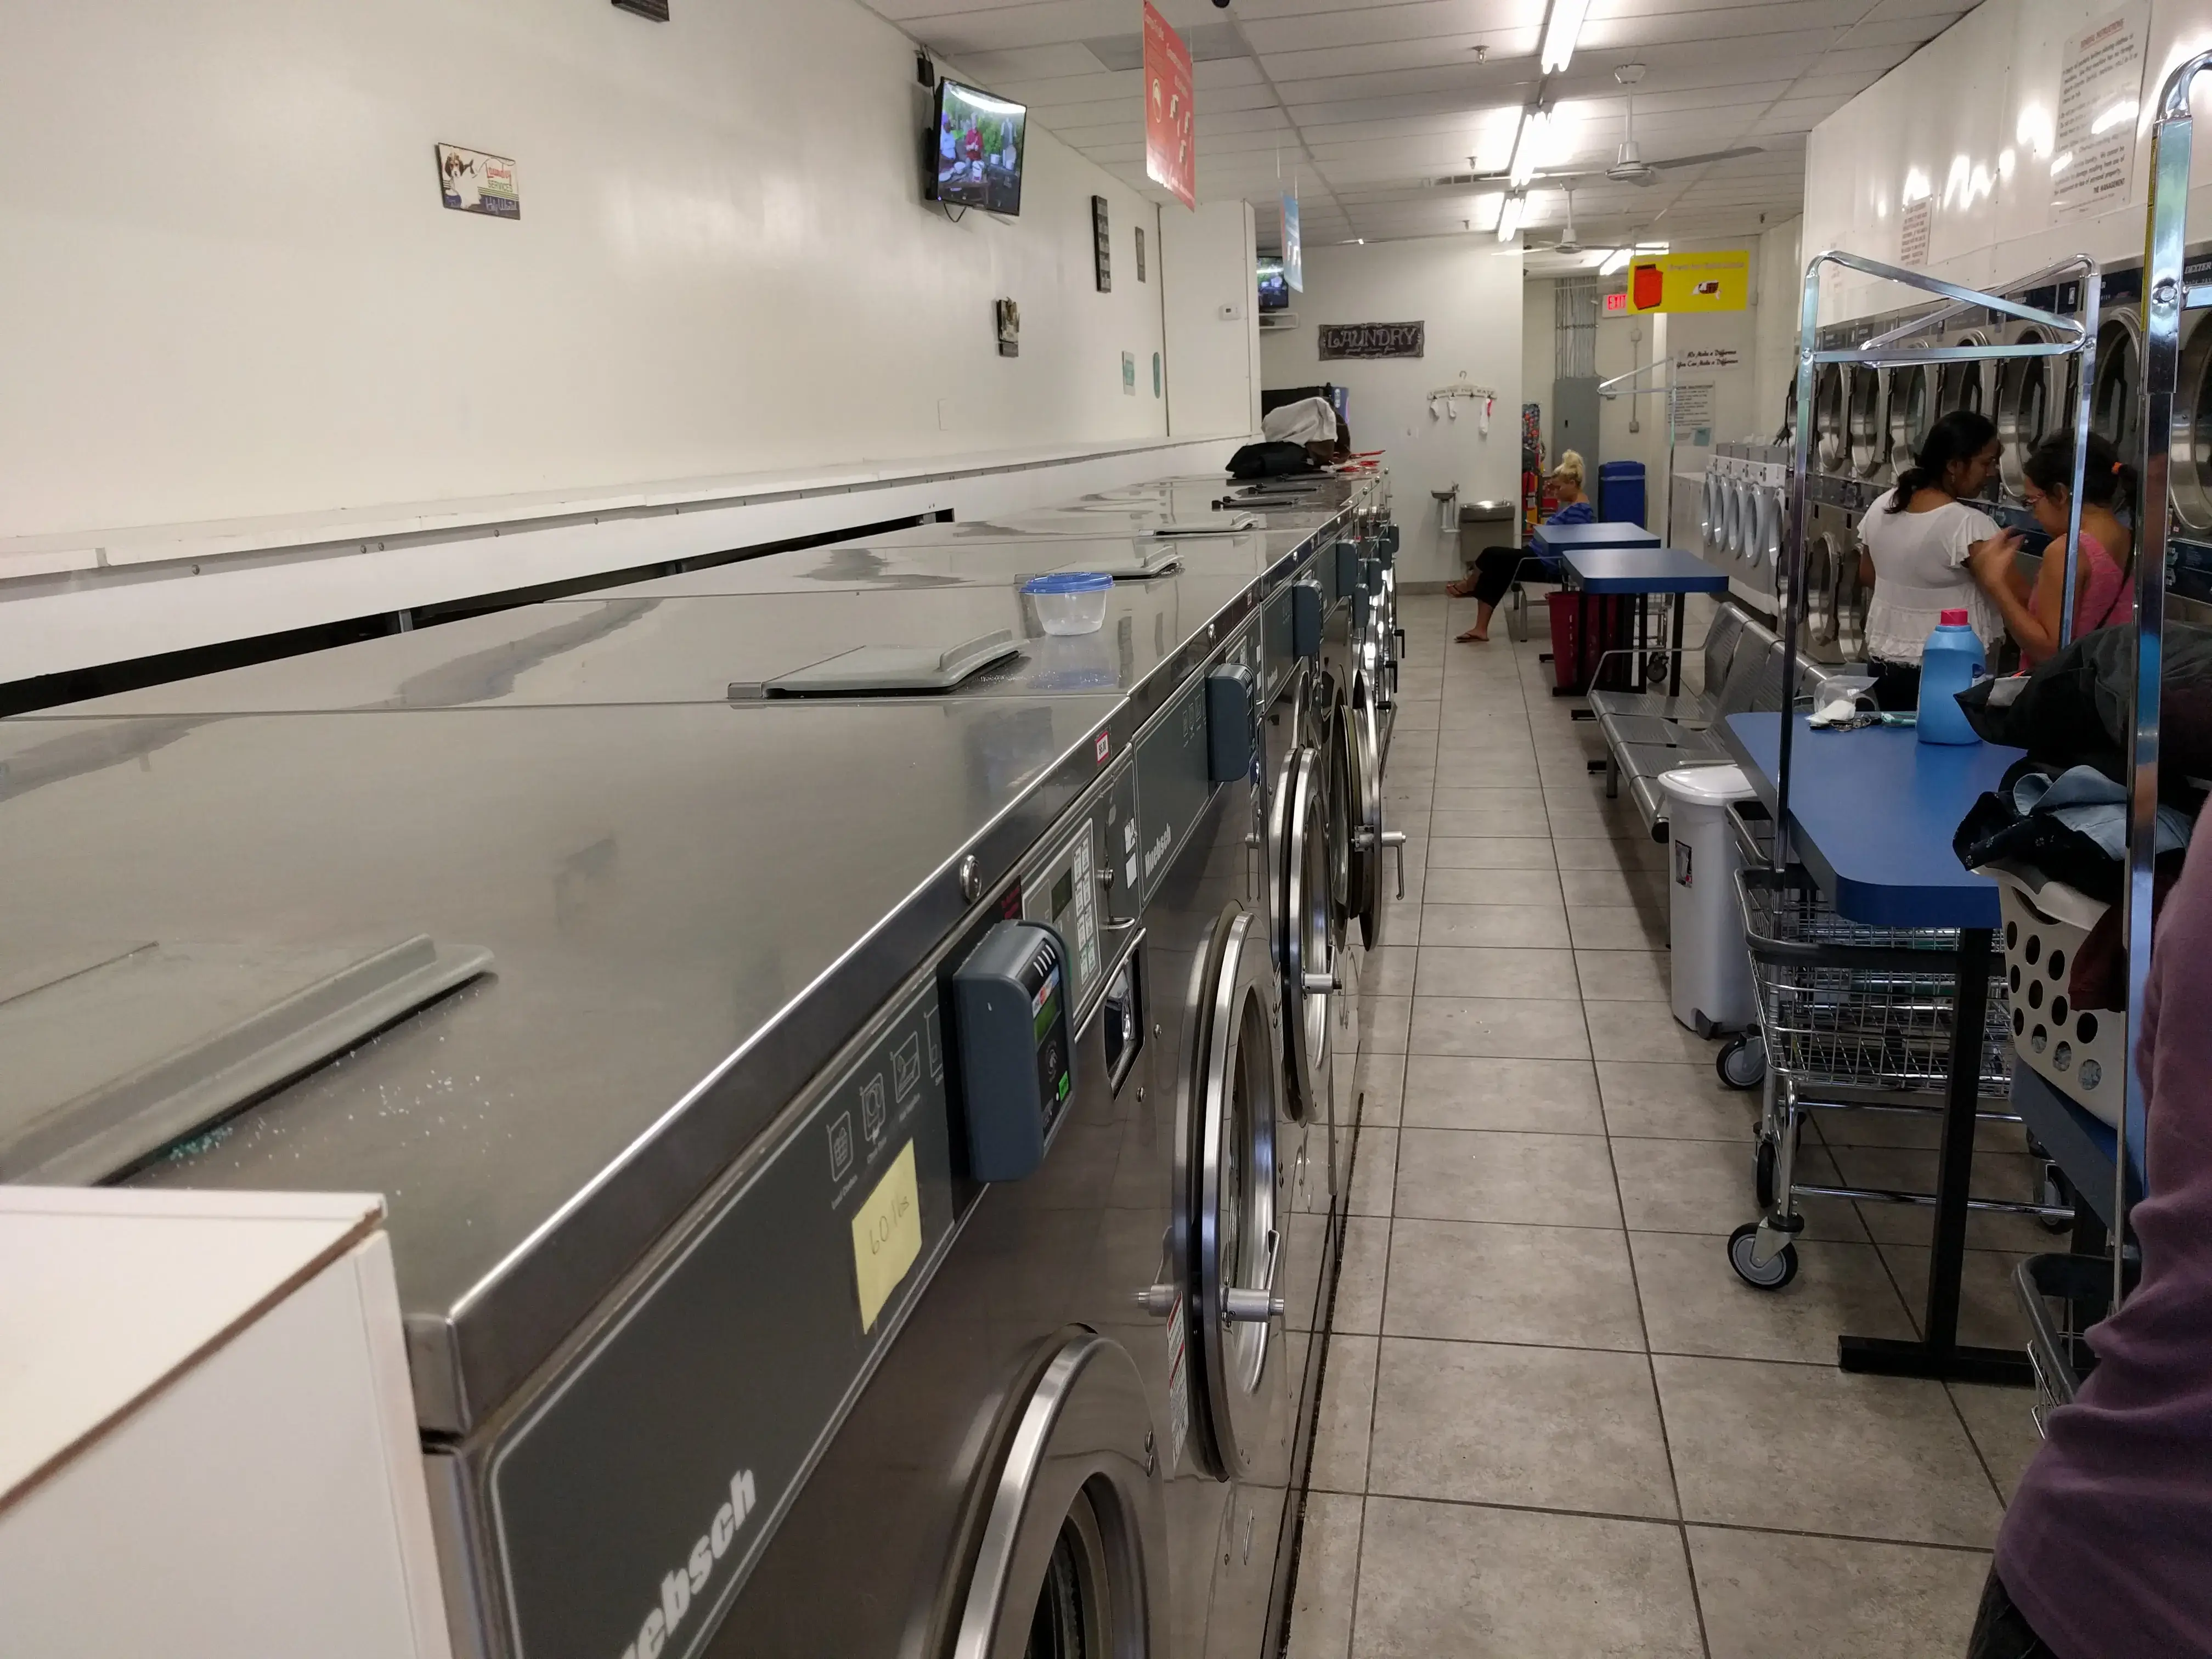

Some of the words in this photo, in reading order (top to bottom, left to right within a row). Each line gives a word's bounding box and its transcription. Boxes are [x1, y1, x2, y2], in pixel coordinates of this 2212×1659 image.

[488, 179, 513, 193] SERVICES
[2185, 261, 2212, 274] DEXTER
[1607, 294, 1627, 311] EXIT
[1328, 329, 1418, 348] LAUNDRY
[1145, 822, 1171, 878] Huebsch
[870, 1216, 889, 1255] 60
[620, 1469, 757, 1659] ebsch
